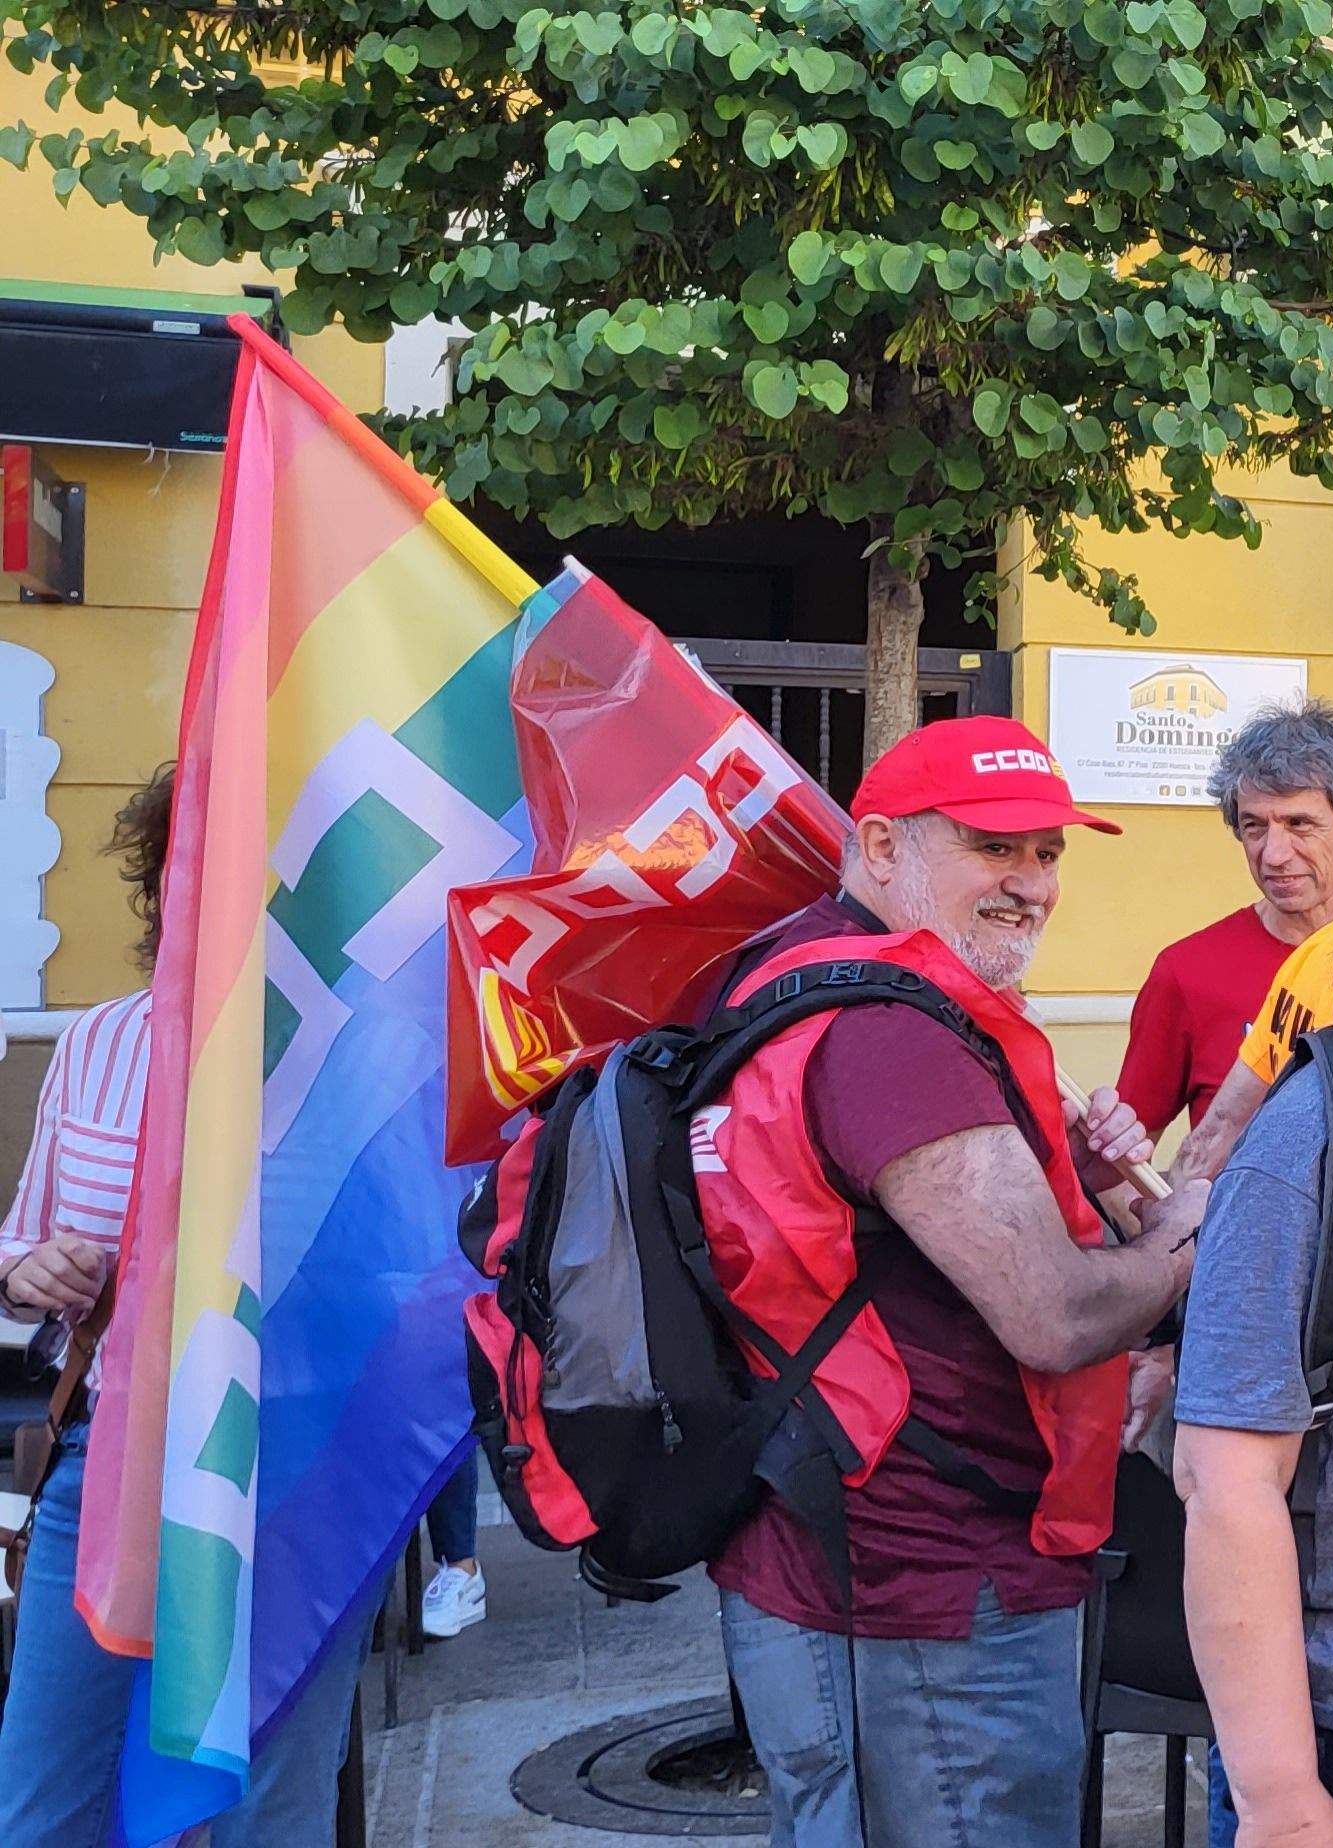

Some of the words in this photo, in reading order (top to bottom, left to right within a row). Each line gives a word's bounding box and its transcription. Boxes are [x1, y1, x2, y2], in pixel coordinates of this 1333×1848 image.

[1136, 711, 1187, 727] Santo
[1115, 720, 1240, 756] Doming
[972, 749, 1051, 774] CCOO
